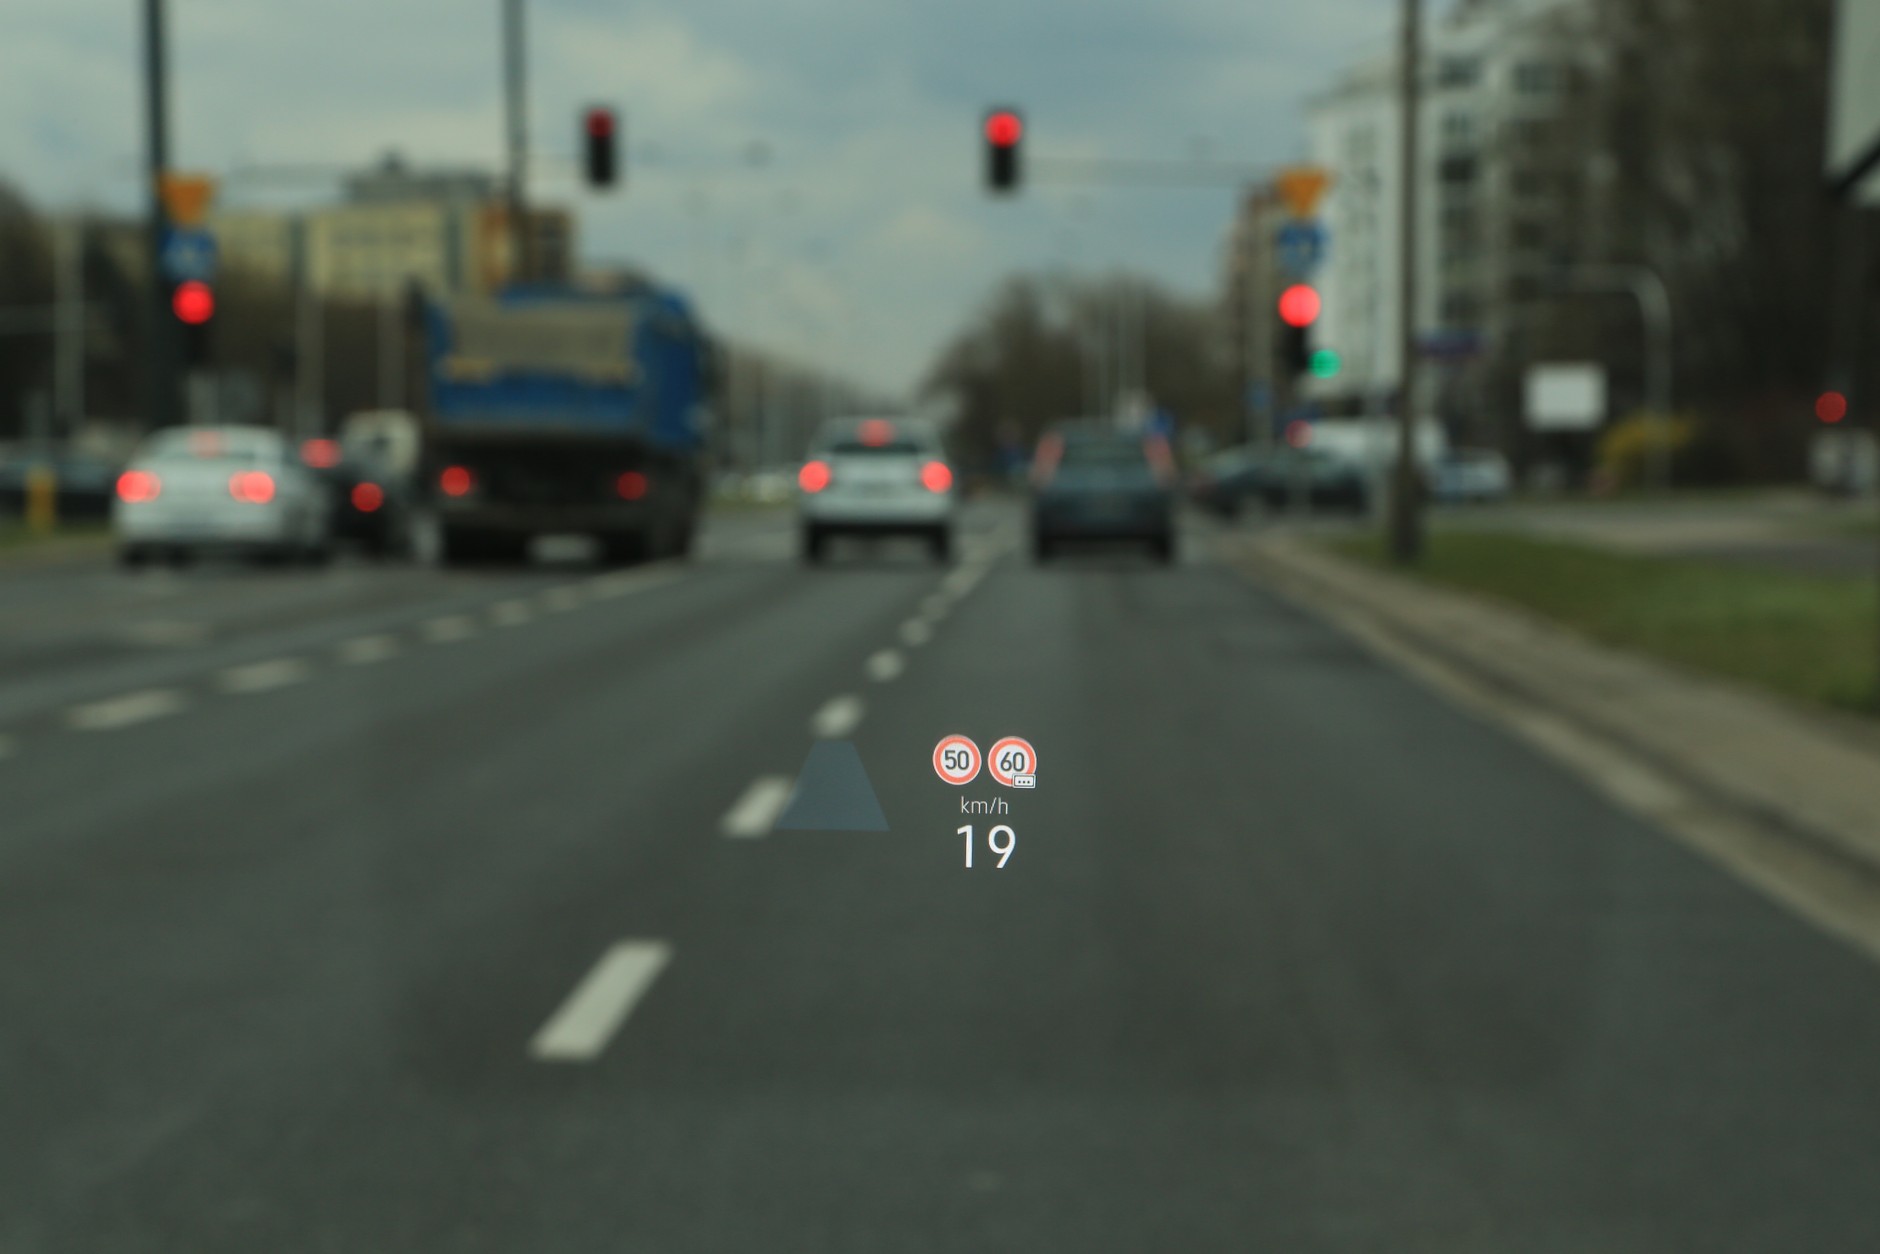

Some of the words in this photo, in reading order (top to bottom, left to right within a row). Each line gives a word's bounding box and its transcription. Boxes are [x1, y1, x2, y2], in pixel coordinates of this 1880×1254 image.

[944, 750, 969, 770] 50
[1000, 752, 1025, 772] 60
[961, 796, 1009, 815] km/h
[957, 825, 1016, 868] 19
